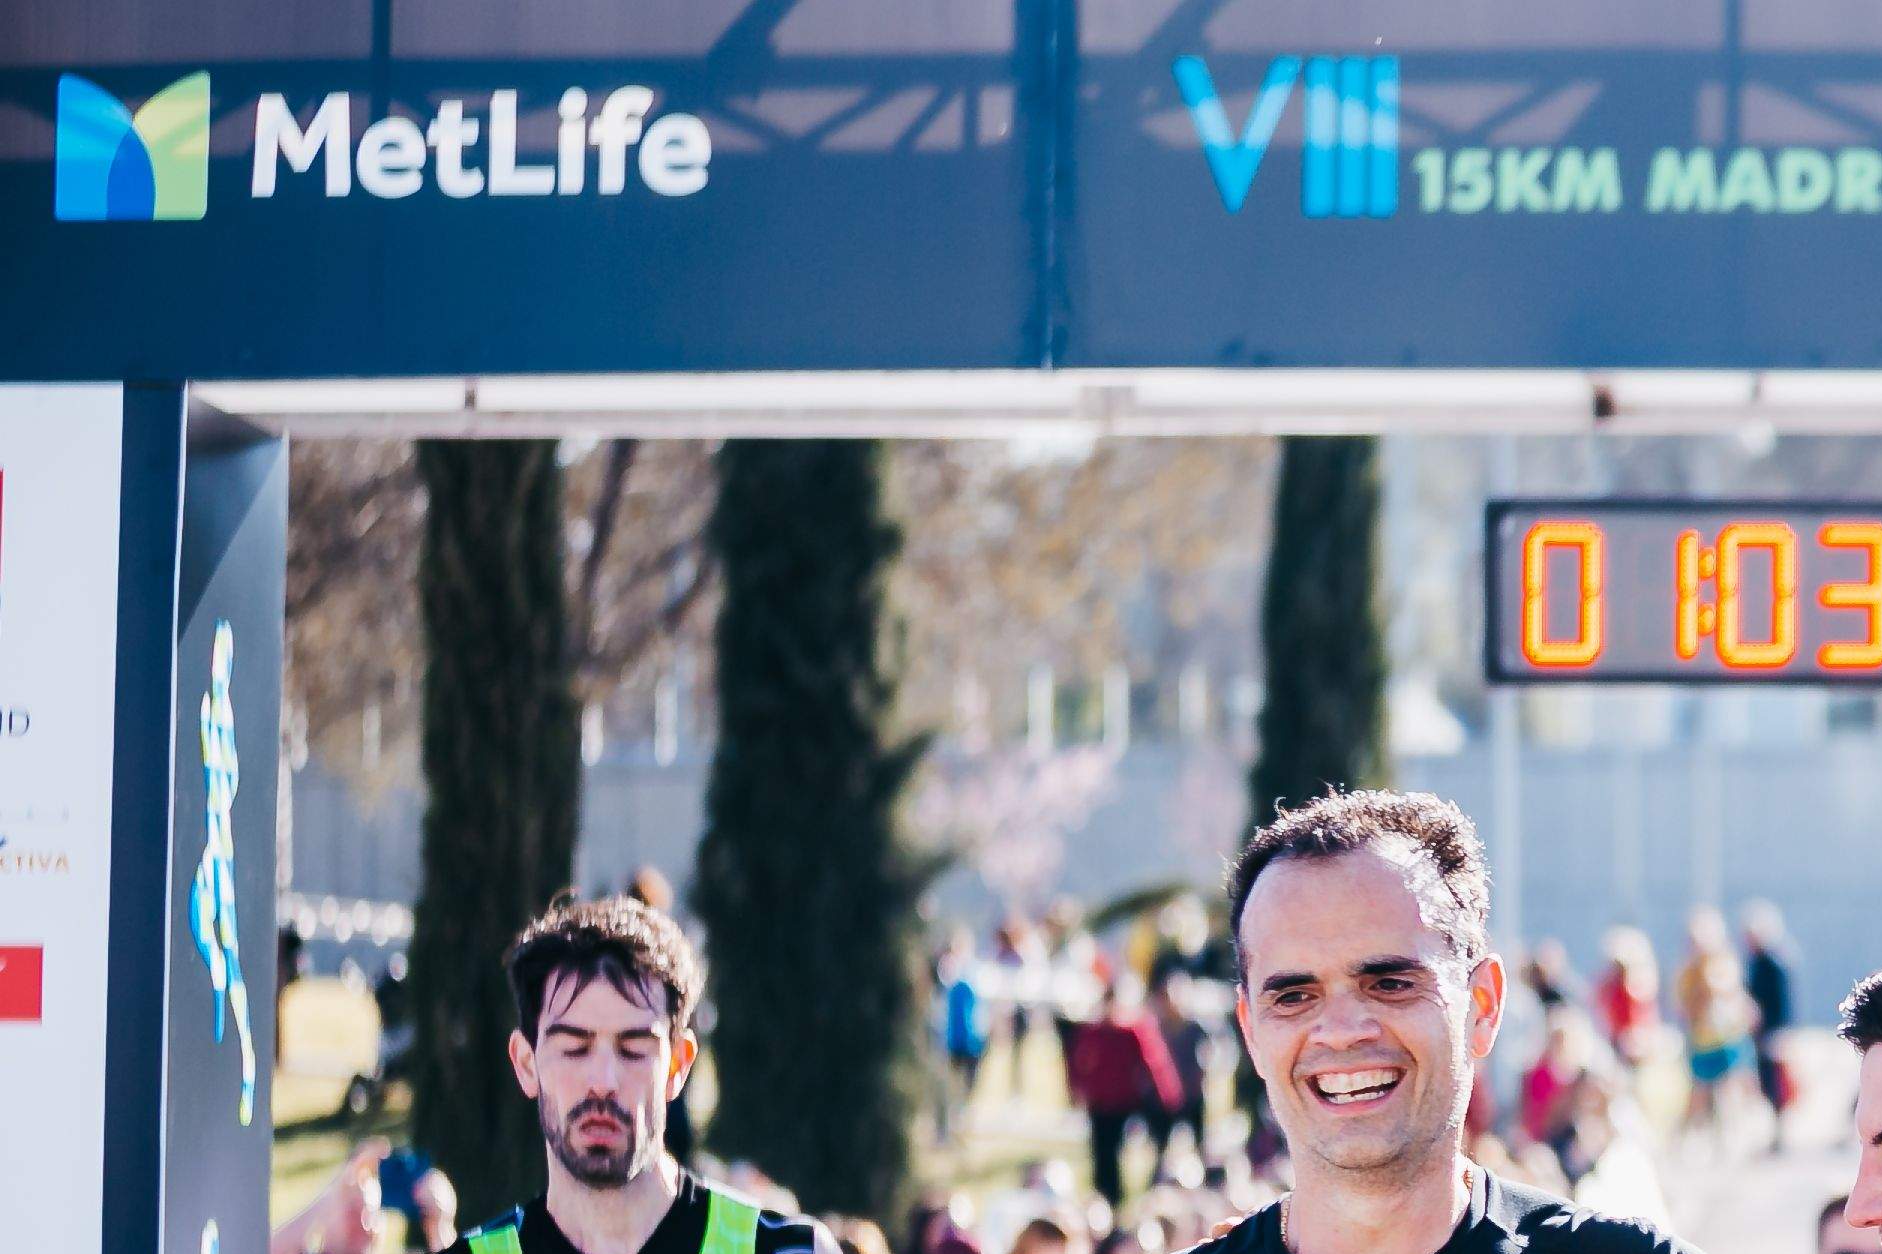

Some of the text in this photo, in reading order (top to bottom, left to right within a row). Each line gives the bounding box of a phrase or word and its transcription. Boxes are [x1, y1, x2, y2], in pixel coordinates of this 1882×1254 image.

[251, 85, 712, 199] MetLife
[1172, 54, 1400, 218] VIII
[1412, 147, 1622, 213] 15KM
